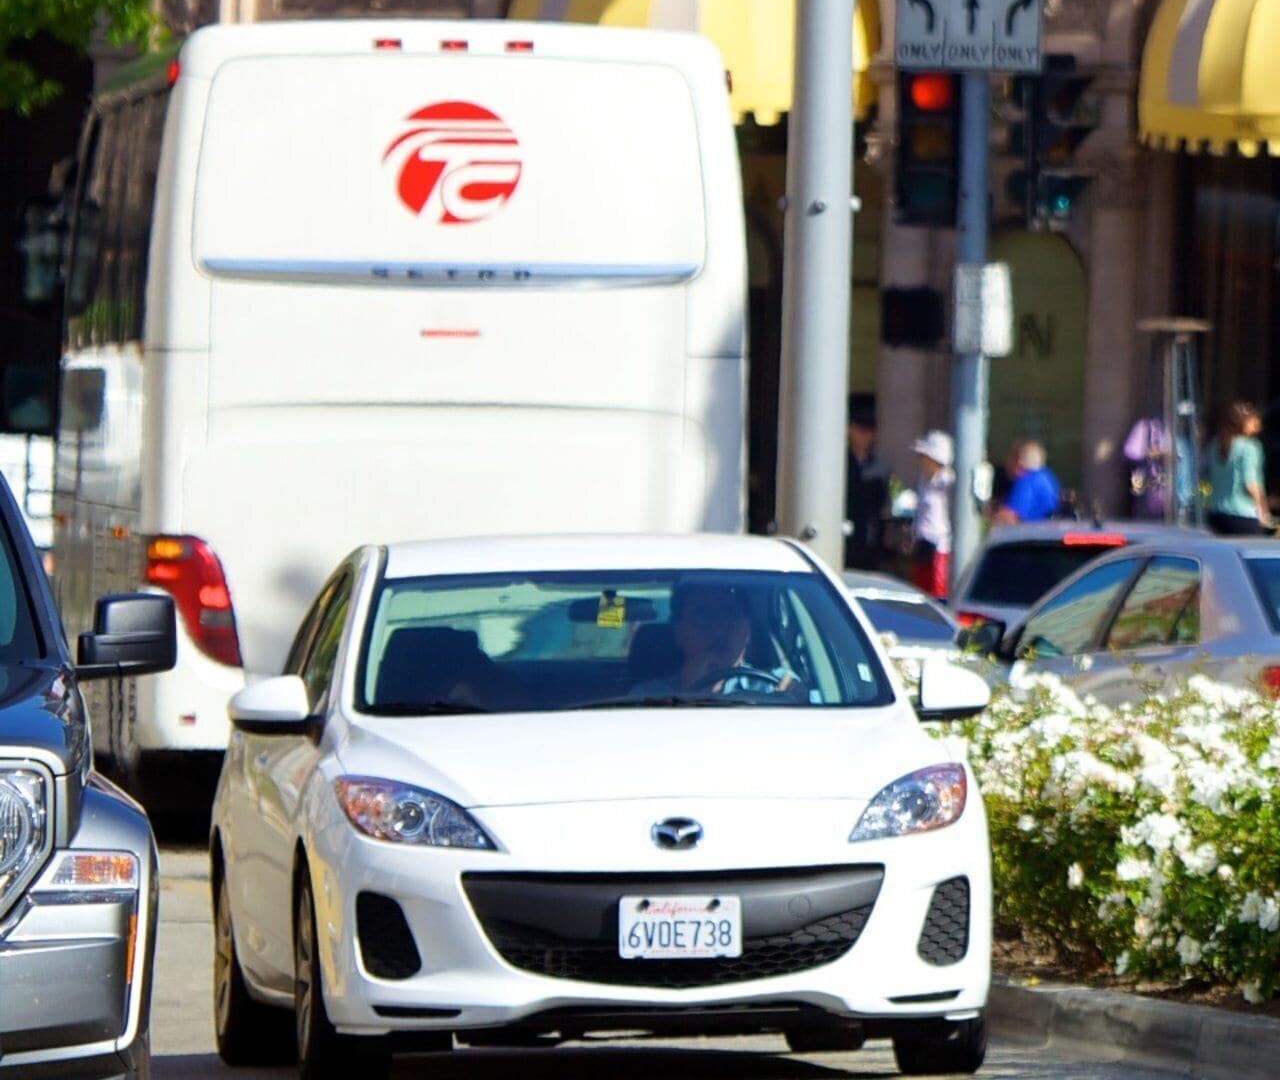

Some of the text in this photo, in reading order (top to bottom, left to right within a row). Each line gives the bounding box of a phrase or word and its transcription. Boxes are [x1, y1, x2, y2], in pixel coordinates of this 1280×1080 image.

[901, 43, 941, 61] ONLY
[948, 44, 988, 62] ONLY
[997, 47, 1035, 63] ONLY
